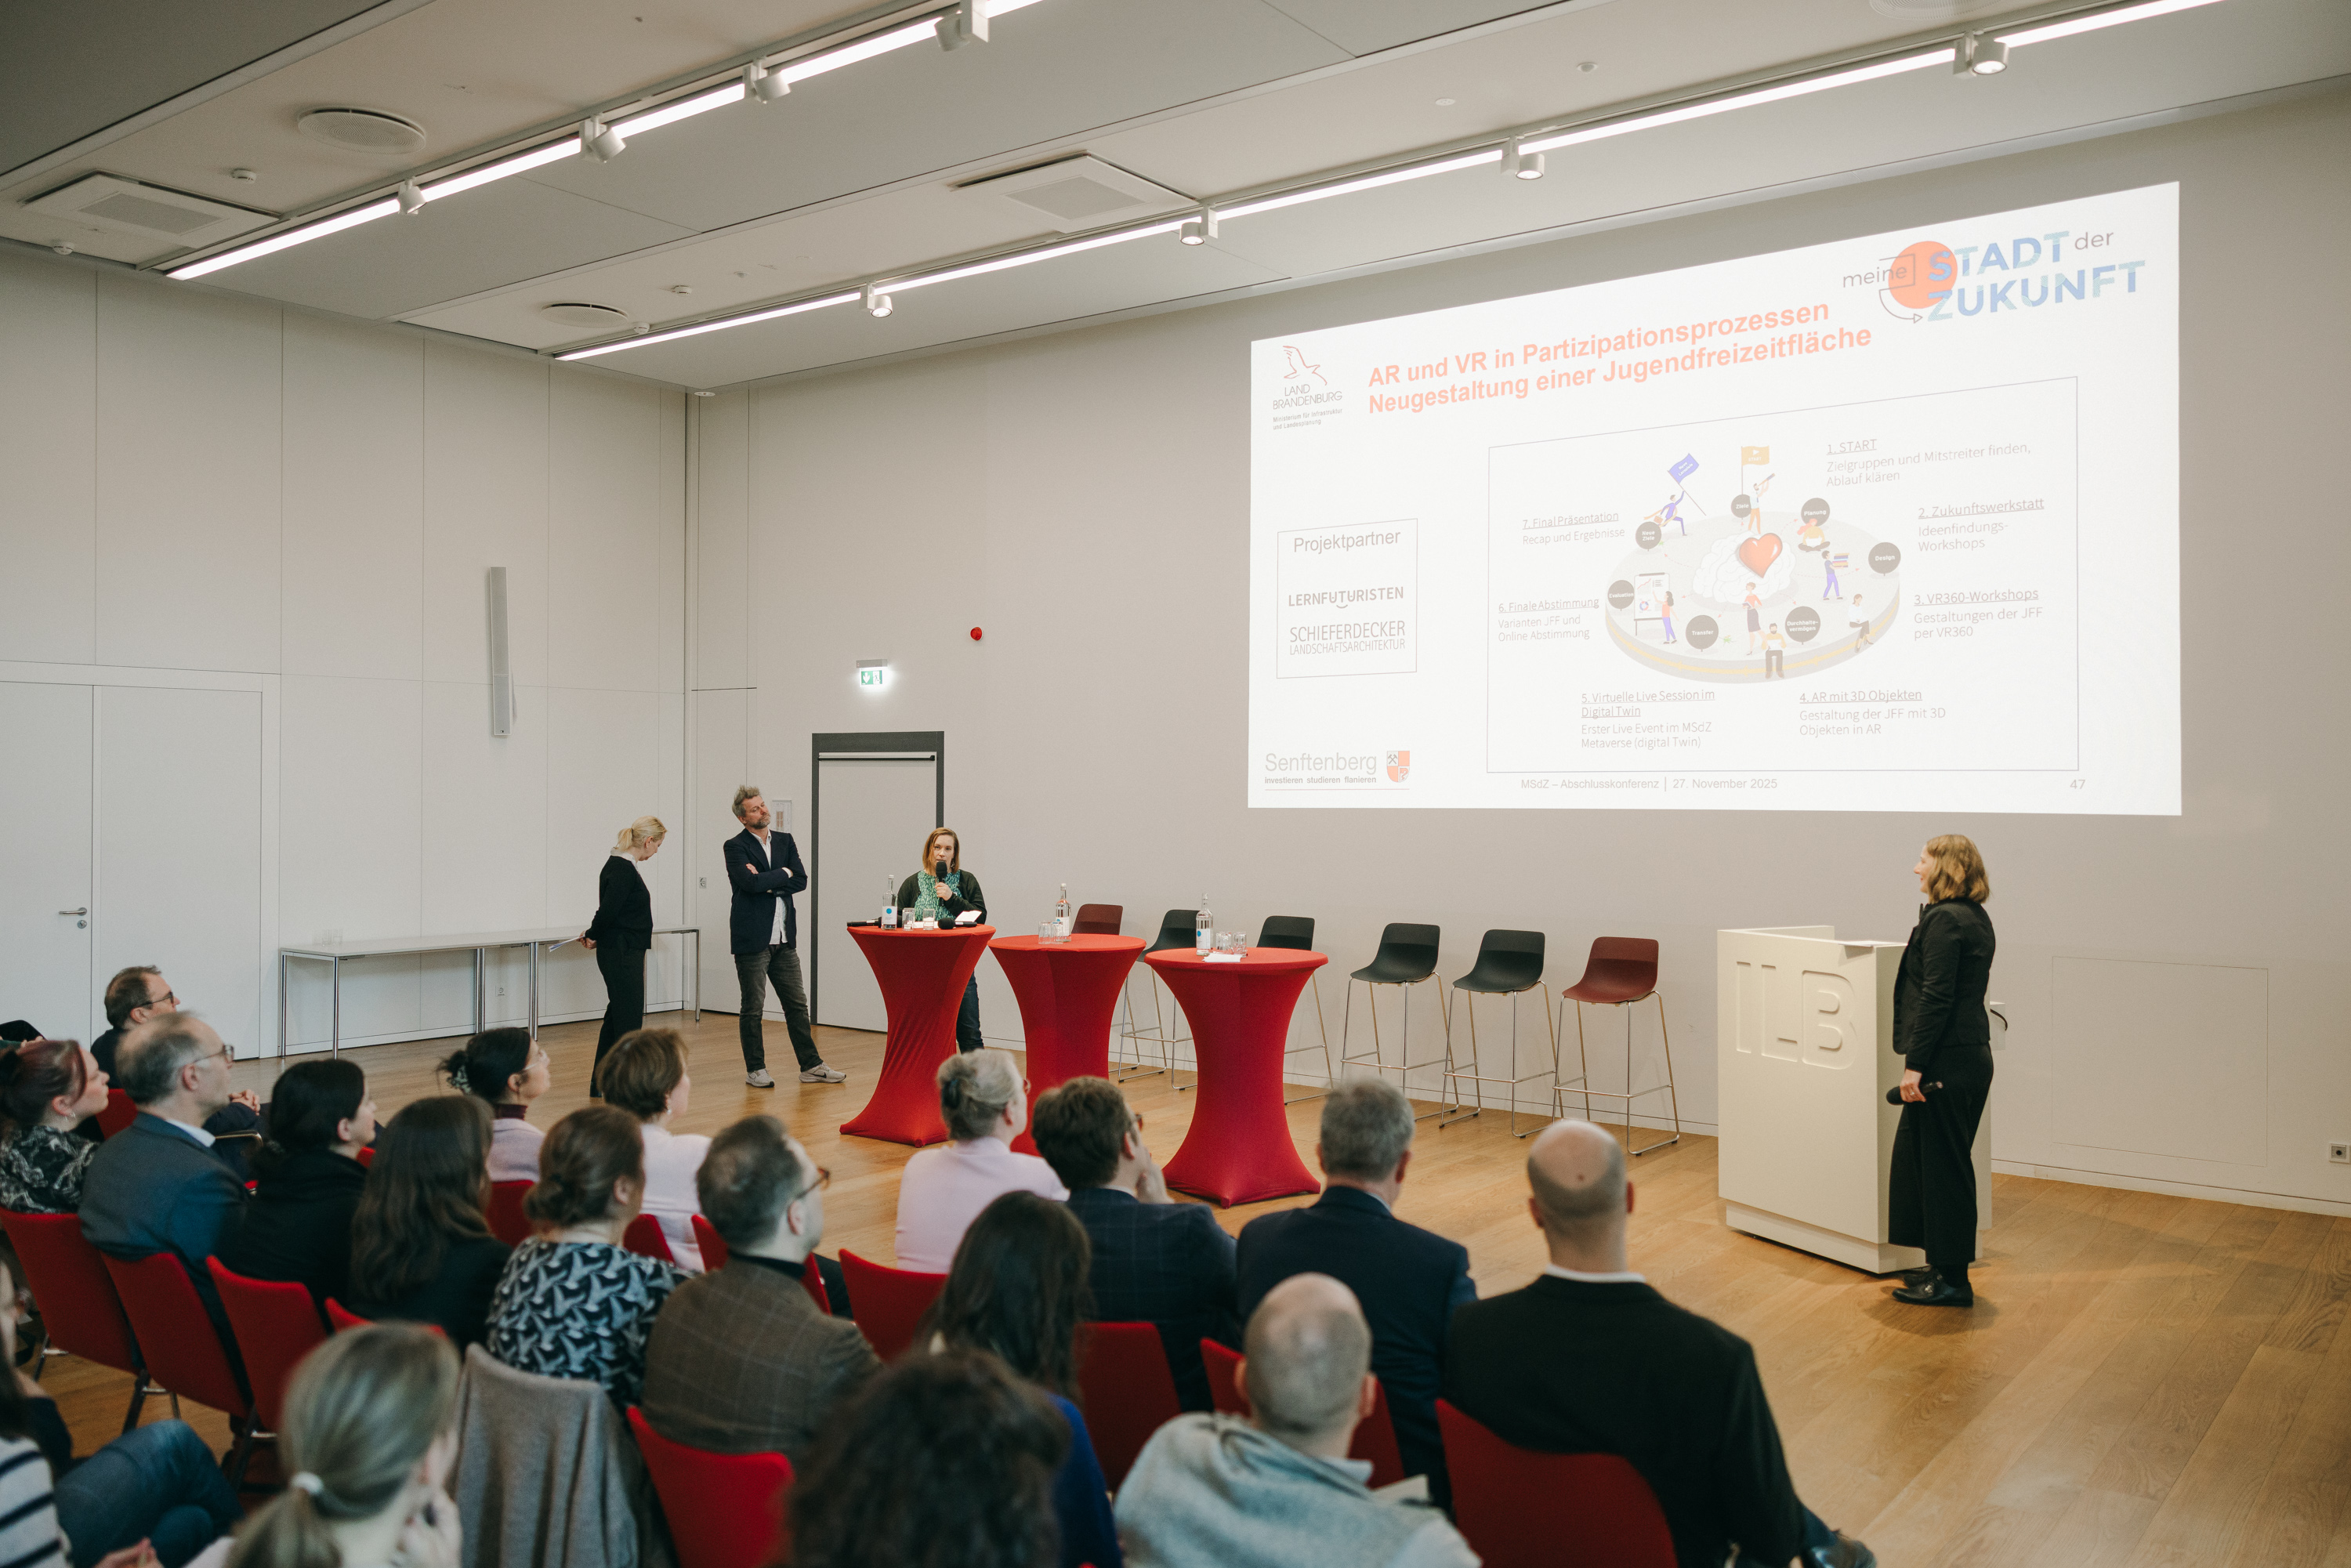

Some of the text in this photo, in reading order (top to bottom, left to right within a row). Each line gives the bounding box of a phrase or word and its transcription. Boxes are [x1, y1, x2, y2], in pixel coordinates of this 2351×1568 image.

[1929, 230, 2114, 282] STADT der
[1843, 266, 1907, 288] meine
[1928, 259, 2145, 321] ZUKUNFT
[1369, 302, 1829, 387] AR und VR in Partizipationsprozessen
[1370, 325, 1871, 414] Neugestaltung einer Jugendfreizeitfläche
[1285, 384, 1310, 397] LAND
[1273, 391, 1342, 409] BRANDENBURG
[1273, 414, 1301, 422] Ministerium
[1312, 408, 1342, 417] Infrastruktur
[1284, 419, 1320, 428] Landesplanung
[1838, 440, 1877, 453] START
[1828, 441, 2031, 475] Zielgruppen und Mitstreiter finden,
[1827, 469, 1900, 487] Ablauf klären
[1918, 499, 2045, 519] 2. Zukunftswerkstatt
[1533, 517, 1557, 527] Final
[1558, 512, 1618, 525] Präsentation
[1523, 528, 1625, 545] Recap und Ergebnisse
[1919, 521, 2009, 537] Ideenfindungs-
[1294, 531, 1400, 555] Projektpartner
[1919, 537, 1985, 552] Workshops
[1288, 586, 1404, 607] LERNFUTURISTEN
[1914, 588, 2038, 605] 3. VR360-Workshops
[1498, 597, 1599, 612] 6. Finale Abstimmung
[1498, 615, 1580, 628] Varianten JFF und
[1914, 607, 2042, 625] Gestaltungen der JFF
[1290, 621, 1405, 643] SCHIEFERDECKER
[1498, 628, 1589, 642] Online Abstimmung
[1914, 626, 1973, 641] per VR360
[1290, 639, 1405, 655] LANDSCHAFTSARCHITEKTUR
[1581, 690, 1715, 702] 5. Virtuelle Live Session im
[1800, 690, 1922, 703] 4. AR mit 3D Objekten
[1581, 706, 1639, 718] Digital Twin
[1800, 708, 1946, 723] Gestaltung der JFF mit 3D
[1581, 722, 1712, 734] Erster Live Event im MSdZ
[1800, 723, 1881, 737] Objekten in AR
[1581, 737, 1701, 750] Metaverse (digital Twin)
[1266, 752, 1377, 774] Senftenberg
[1521, 779, 1549, 789] MSdZ
[1560, 778, 1659, 788] Abschlusskonferenz
[1673, 779, 1689, 788] 27.
[1694, 778, 1747, 788] November
[1750, 778, 1777, 788] 2025
[2070, 779, 2085, 790] 47
[1736, 961, 1857, 1070] ILB
